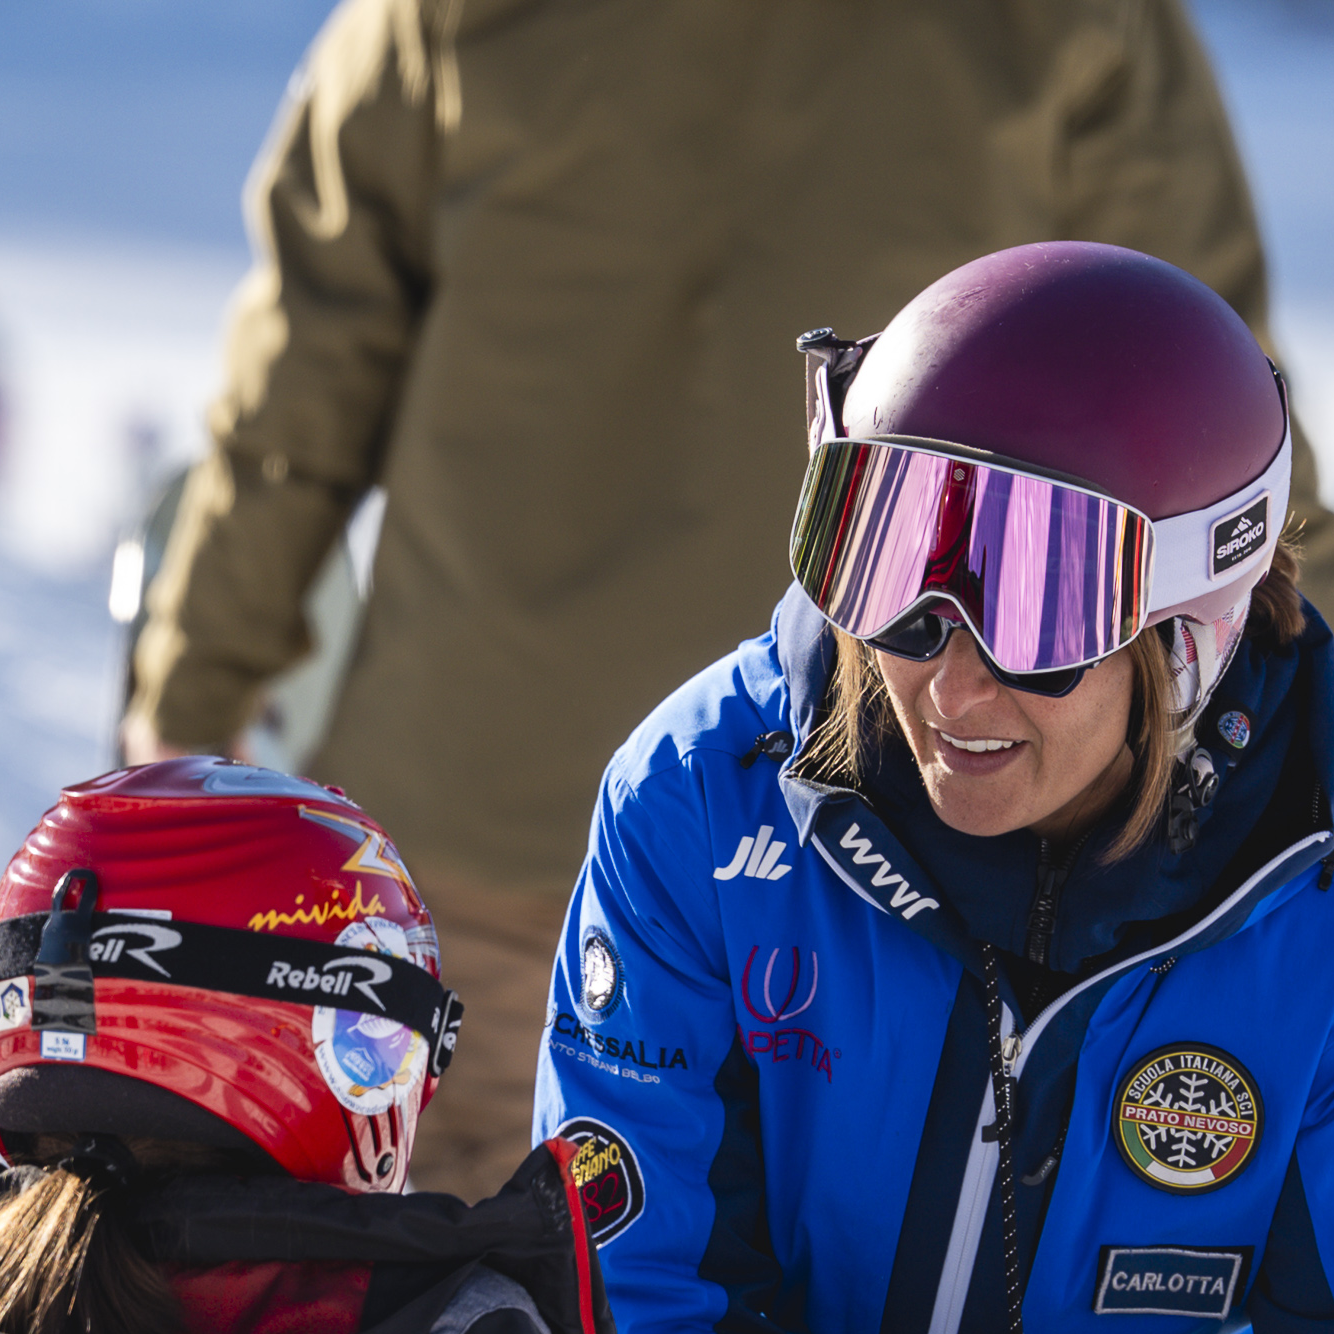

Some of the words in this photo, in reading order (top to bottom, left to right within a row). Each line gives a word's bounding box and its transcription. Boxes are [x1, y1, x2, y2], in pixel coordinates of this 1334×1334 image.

[1216, 521, 1264, 559] SIROKO
[248, 880, 386, 932] mivida
[1128, 1058, 1175, 1100] SCUOLA
[1180, 1055, 1241, 1091] ITALIANA
[1237, 1091, 1254, 1116] SCI
[1125, 1106, 1180, 1125] PRATO
[1183, 1115, 1253, 1136] NEVOSO
[1112, 1271, 1225, 1296] CARLOTTA
